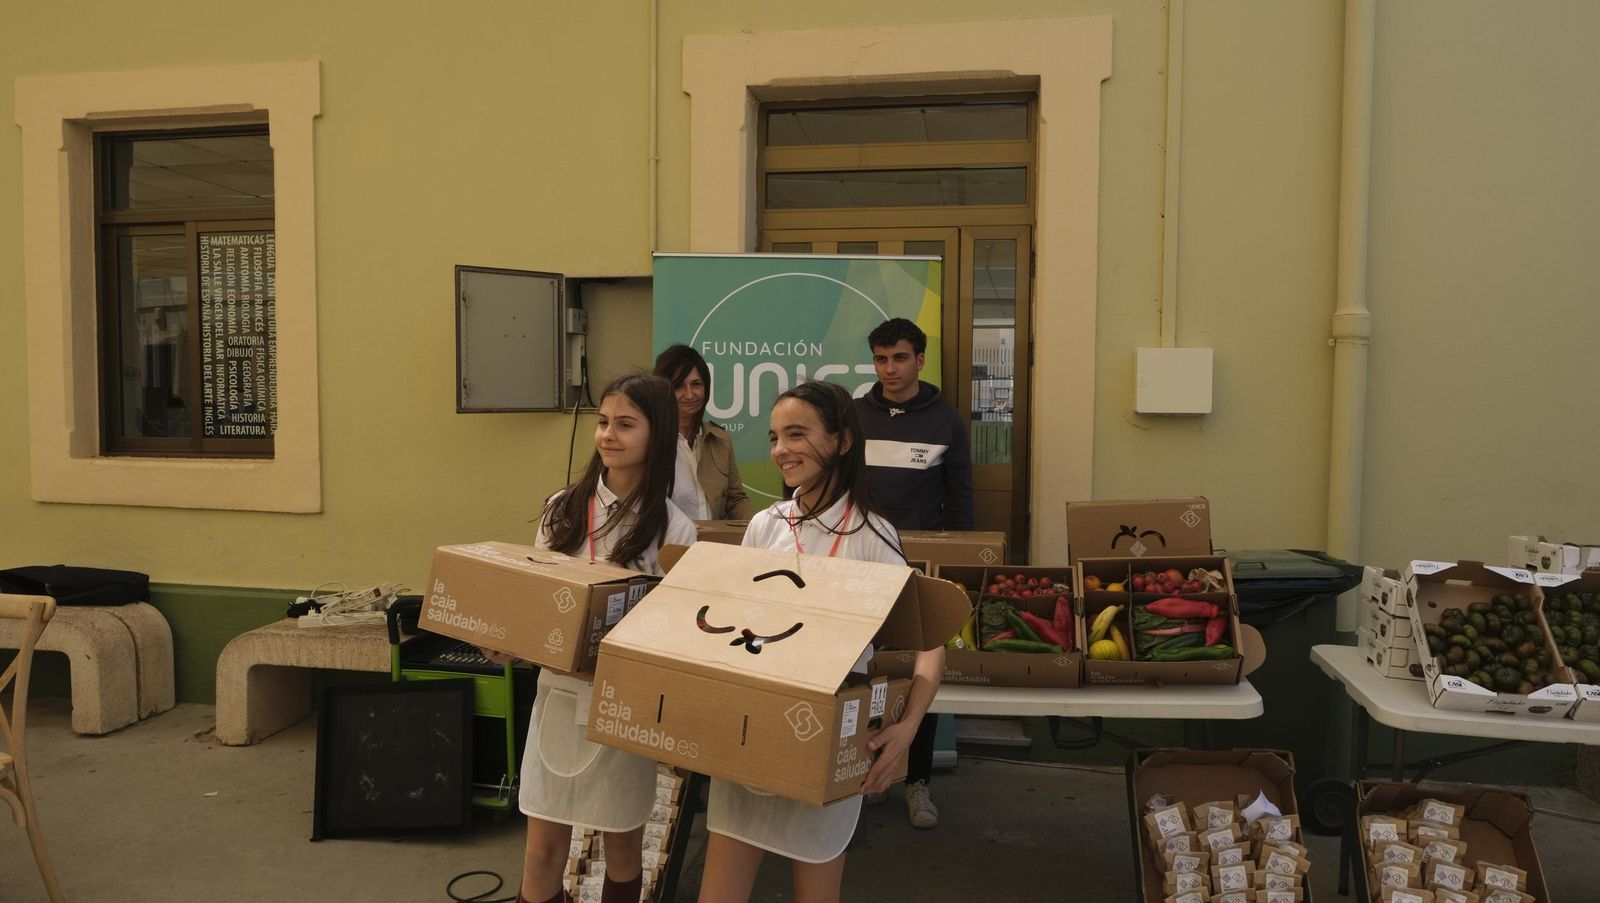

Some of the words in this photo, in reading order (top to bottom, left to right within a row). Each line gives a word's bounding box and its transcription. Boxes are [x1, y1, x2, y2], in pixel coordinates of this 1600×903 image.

[211, 235, 264, 246] MATEMATICAS
[200, 236, 210, 274] HISTORIA
[213, 248, 221, 259] LA
[267, 235, 275, 268] LENGUA
[213, 261, 222, 286] SALLE
[226, 248, 236, 286] RELIGIÓN
[241, 247, 251, 292] ANATOMÍA
[254, 247, 264, 290] FILOSOFÍA
[214, 288, 223, 320] VIRGEN
[227, 289, 238, 334] ECONOMÍA
[254, 294, 265, 332] FRANCÉS
[215, 322, 223, 338] DEL
[203, 323, 212, 362] HISTORIA
[216, 340, 224, 360] MAR
[228, 336, 264, 346] ORATORIA
[702, 340, 822, 356] FUNDACIÓN
[227, 348, 253, 357] DIBUJO
[204, 365, 212, 380] DEL
[204, 382, 212, 404] ARTE
[229, 360, 239, 410] PSICOLOGÍA
[243, 360, 253, 407] GEOGRAFÍA
[256, 375, 266, 411] QUÍMICA
[232, 413, 265, 422] HISTORIA
[720, 423, 744, 432] OUP
[220, 426, 266, 435] LITERATURA
[434, 578, 445, 594] la
[430, 594, 456, 611] caja
[602, 680, 615, 699] la
[598, 701, 632, 720] caja
[837, 744, 857, 765] caja
[834, 754, 874, 782] saludab
